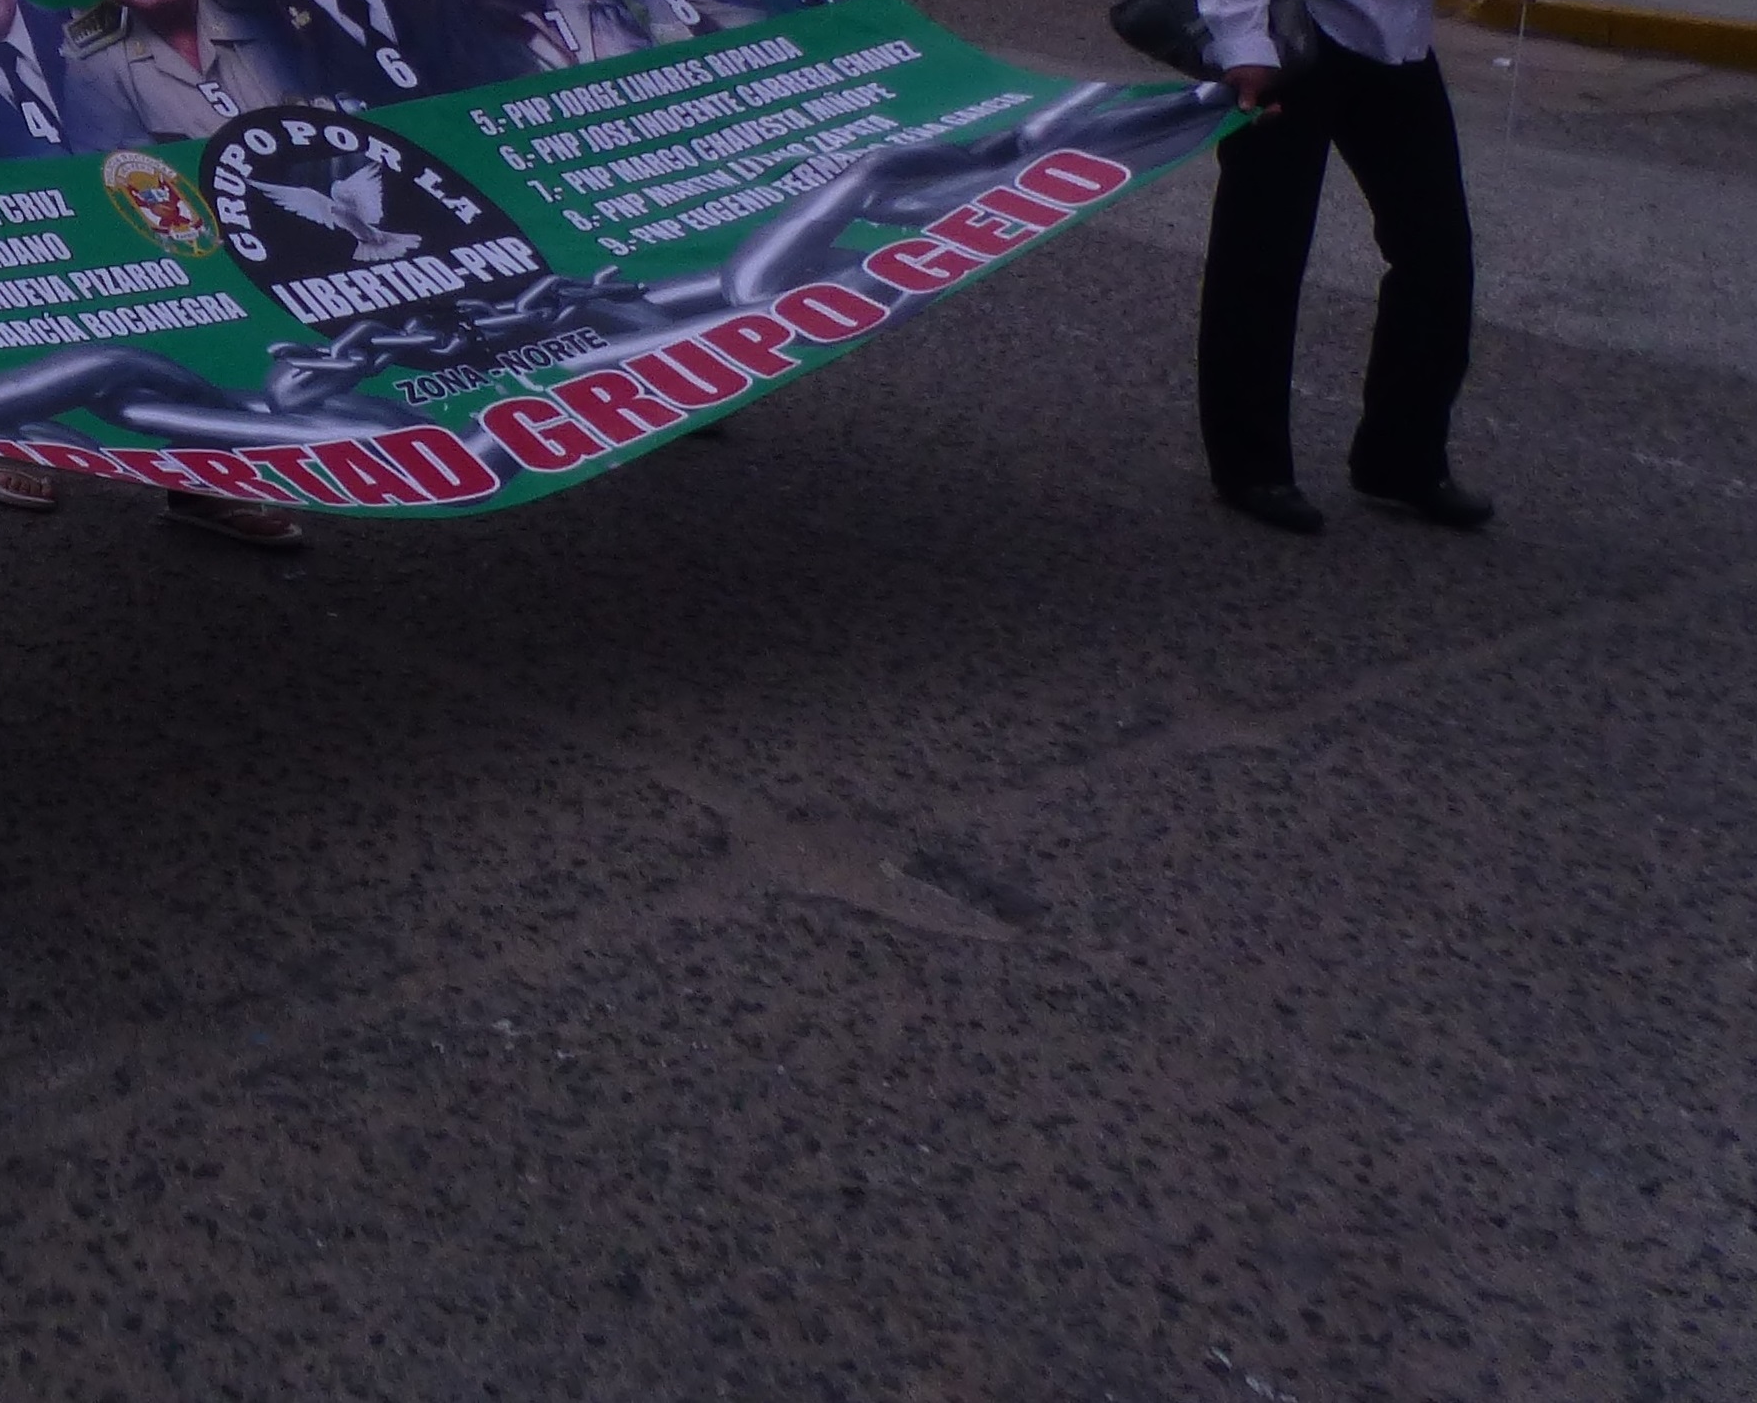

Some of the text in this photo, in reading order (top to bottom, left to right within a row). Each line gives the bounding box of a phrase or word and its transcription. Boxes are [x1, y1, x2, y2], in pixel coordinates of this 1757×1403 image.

[545, 8, 580, 52] 7
[375, 47, 419, 90] 6
[501, 96, 554, 130] PNP
[548, 80, 627, 119] JORGE
[616, 59, 714, 103] LINARES
[704, 35, 804, 78] RIPALDA
[21, 101, 62, 144] 4
[196, 81, 240, 119] 5
[530, 132, 583, 165] PNP
[578, 118, 642, 153] JOSE
[628, 90, 746, 139] INOCENTE
[735, 61, 845, 107] CABRERA
[831, 39, 923, 78] CHAVEZ
[561, 165, 615, 195] PNP
[607, 144, 699, 183] MARCO
[690, 107, 816, 161] CHAVESTA
[213, 128, 278, 263] GRUPO
[280, 118, 402, 174] POR
[413, 166, 482, 226] LA
[594, 192, 650, 223] PNP
[641, 168, 742, 208] MARTIN
[629, 218, 687, 245] PNP
[676, 185, 786, 232] EUGENIO
[67, 257, 191, 300] PIZARRO
[76, 291, 249, 339] BOCANEGRA
[479, 282, 890, 474] GRUPO
[862, 148, 1133, 295] GEIO
[394, 364, 493, 408] ZONA
